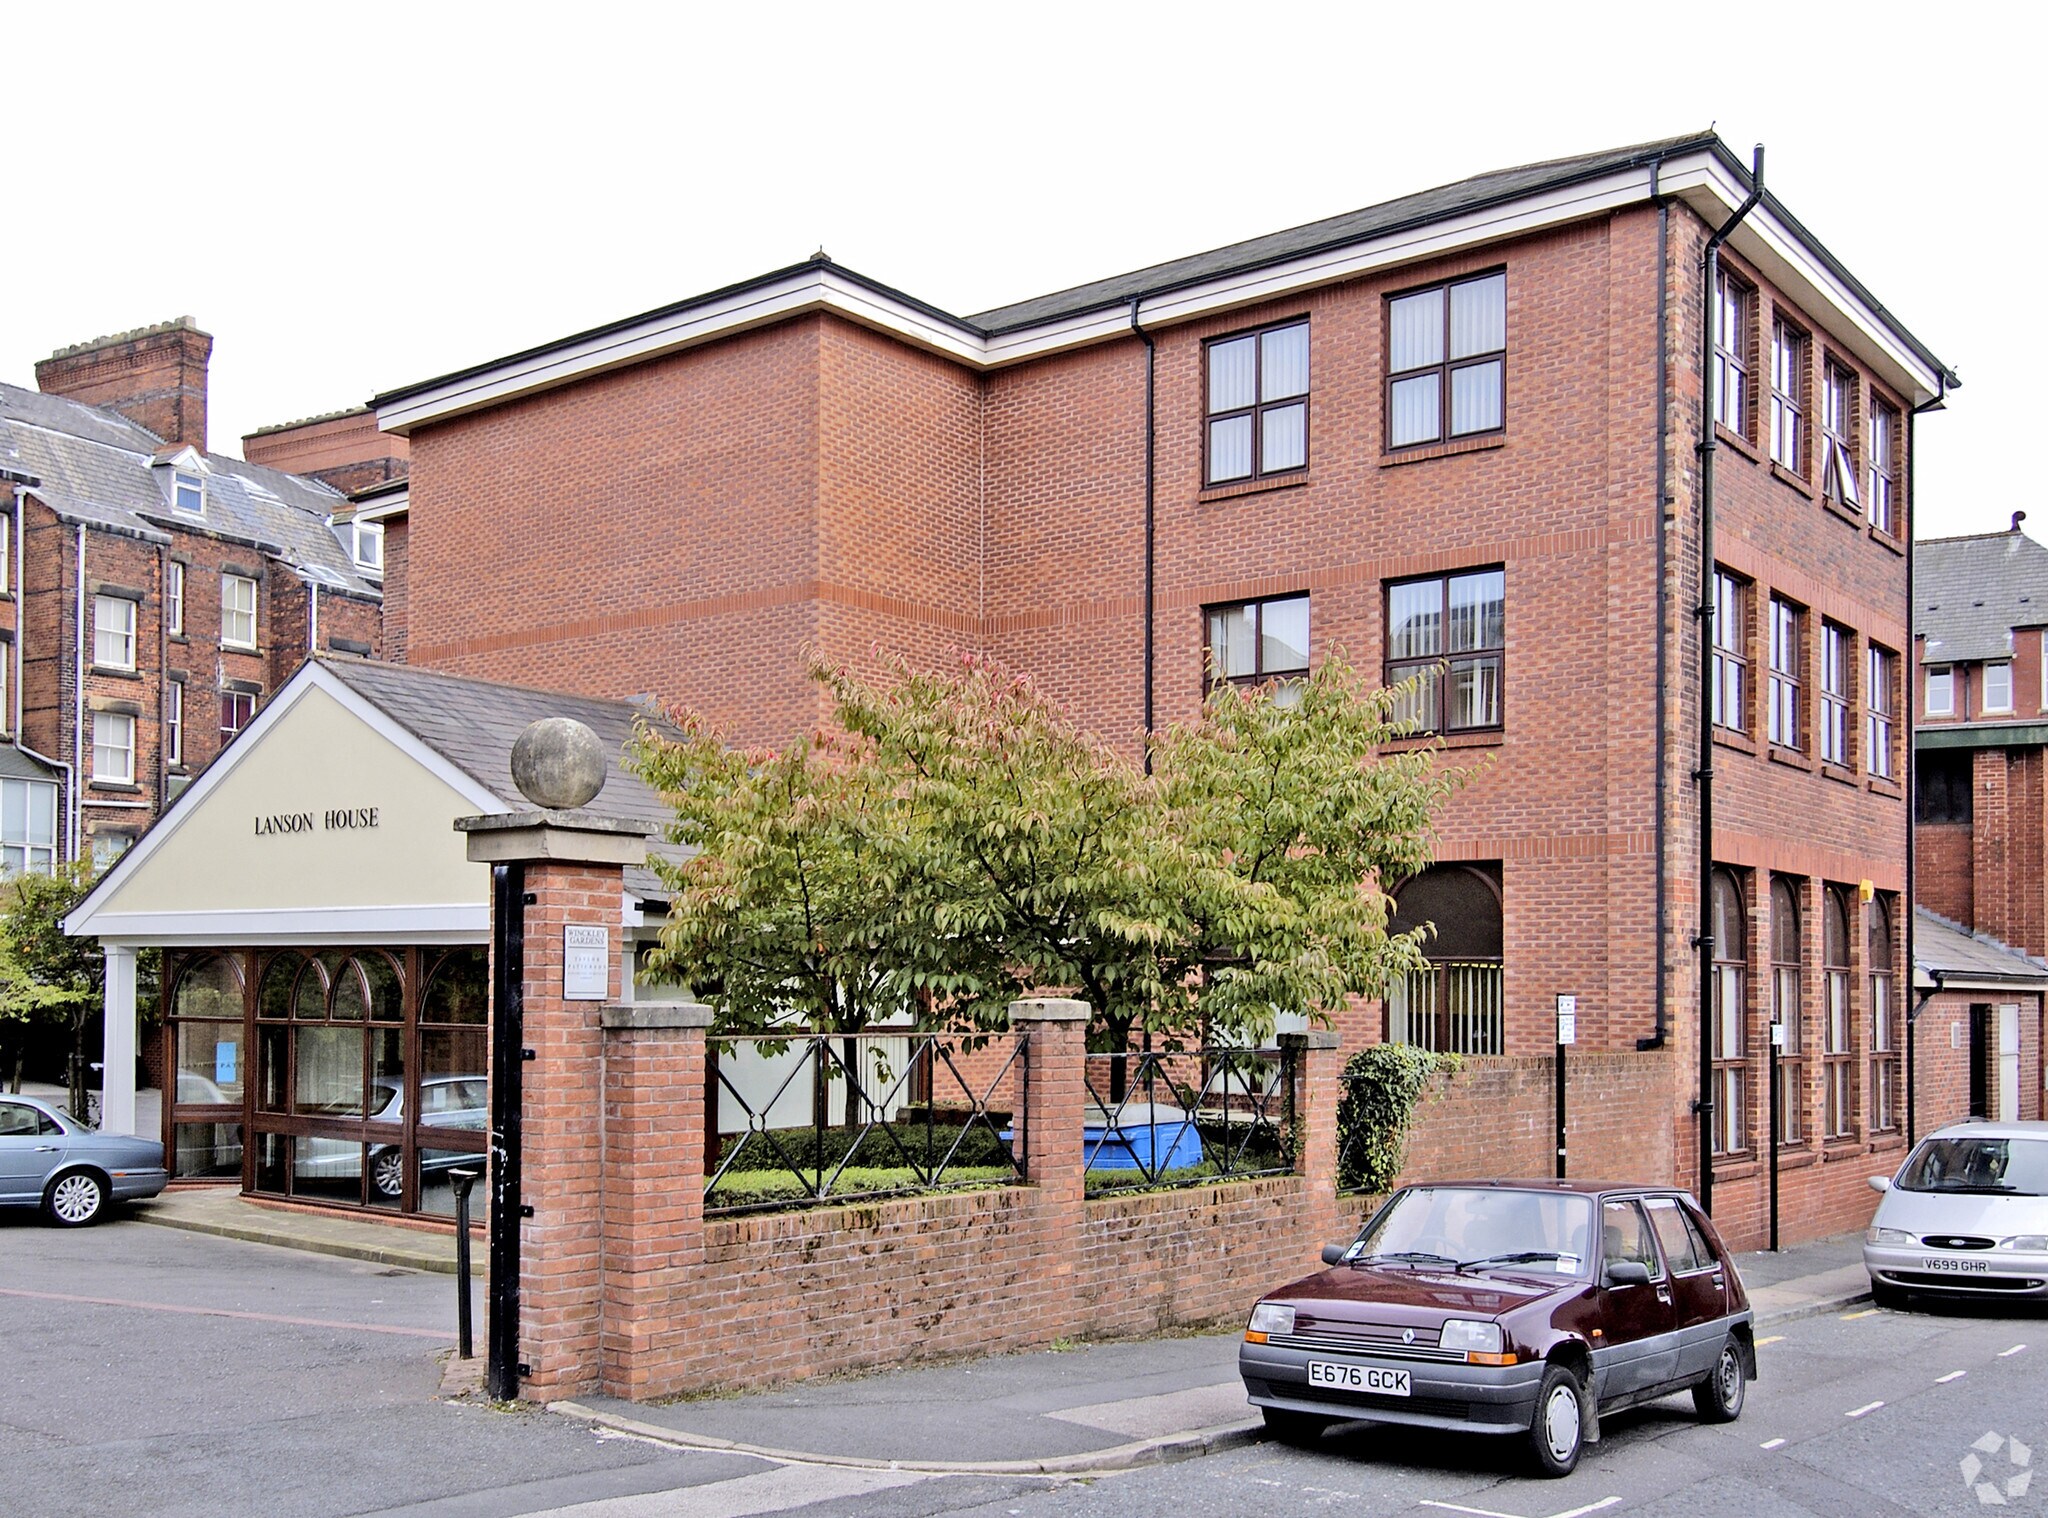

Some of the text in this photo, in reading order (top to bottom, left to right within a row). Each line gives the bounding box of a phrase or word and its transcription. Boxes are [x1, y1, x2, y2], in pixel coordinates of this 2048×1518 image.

[254, 807, 380, 836] LANSON HOUSE
[567, 929, 606, 938] WINCKLEY
[569, 936, 605, 945] GARDENS
[1925, 1258, 1988, 1273] V699 GHR
[1311, 1363, 1408, 1391] E676 GCK
